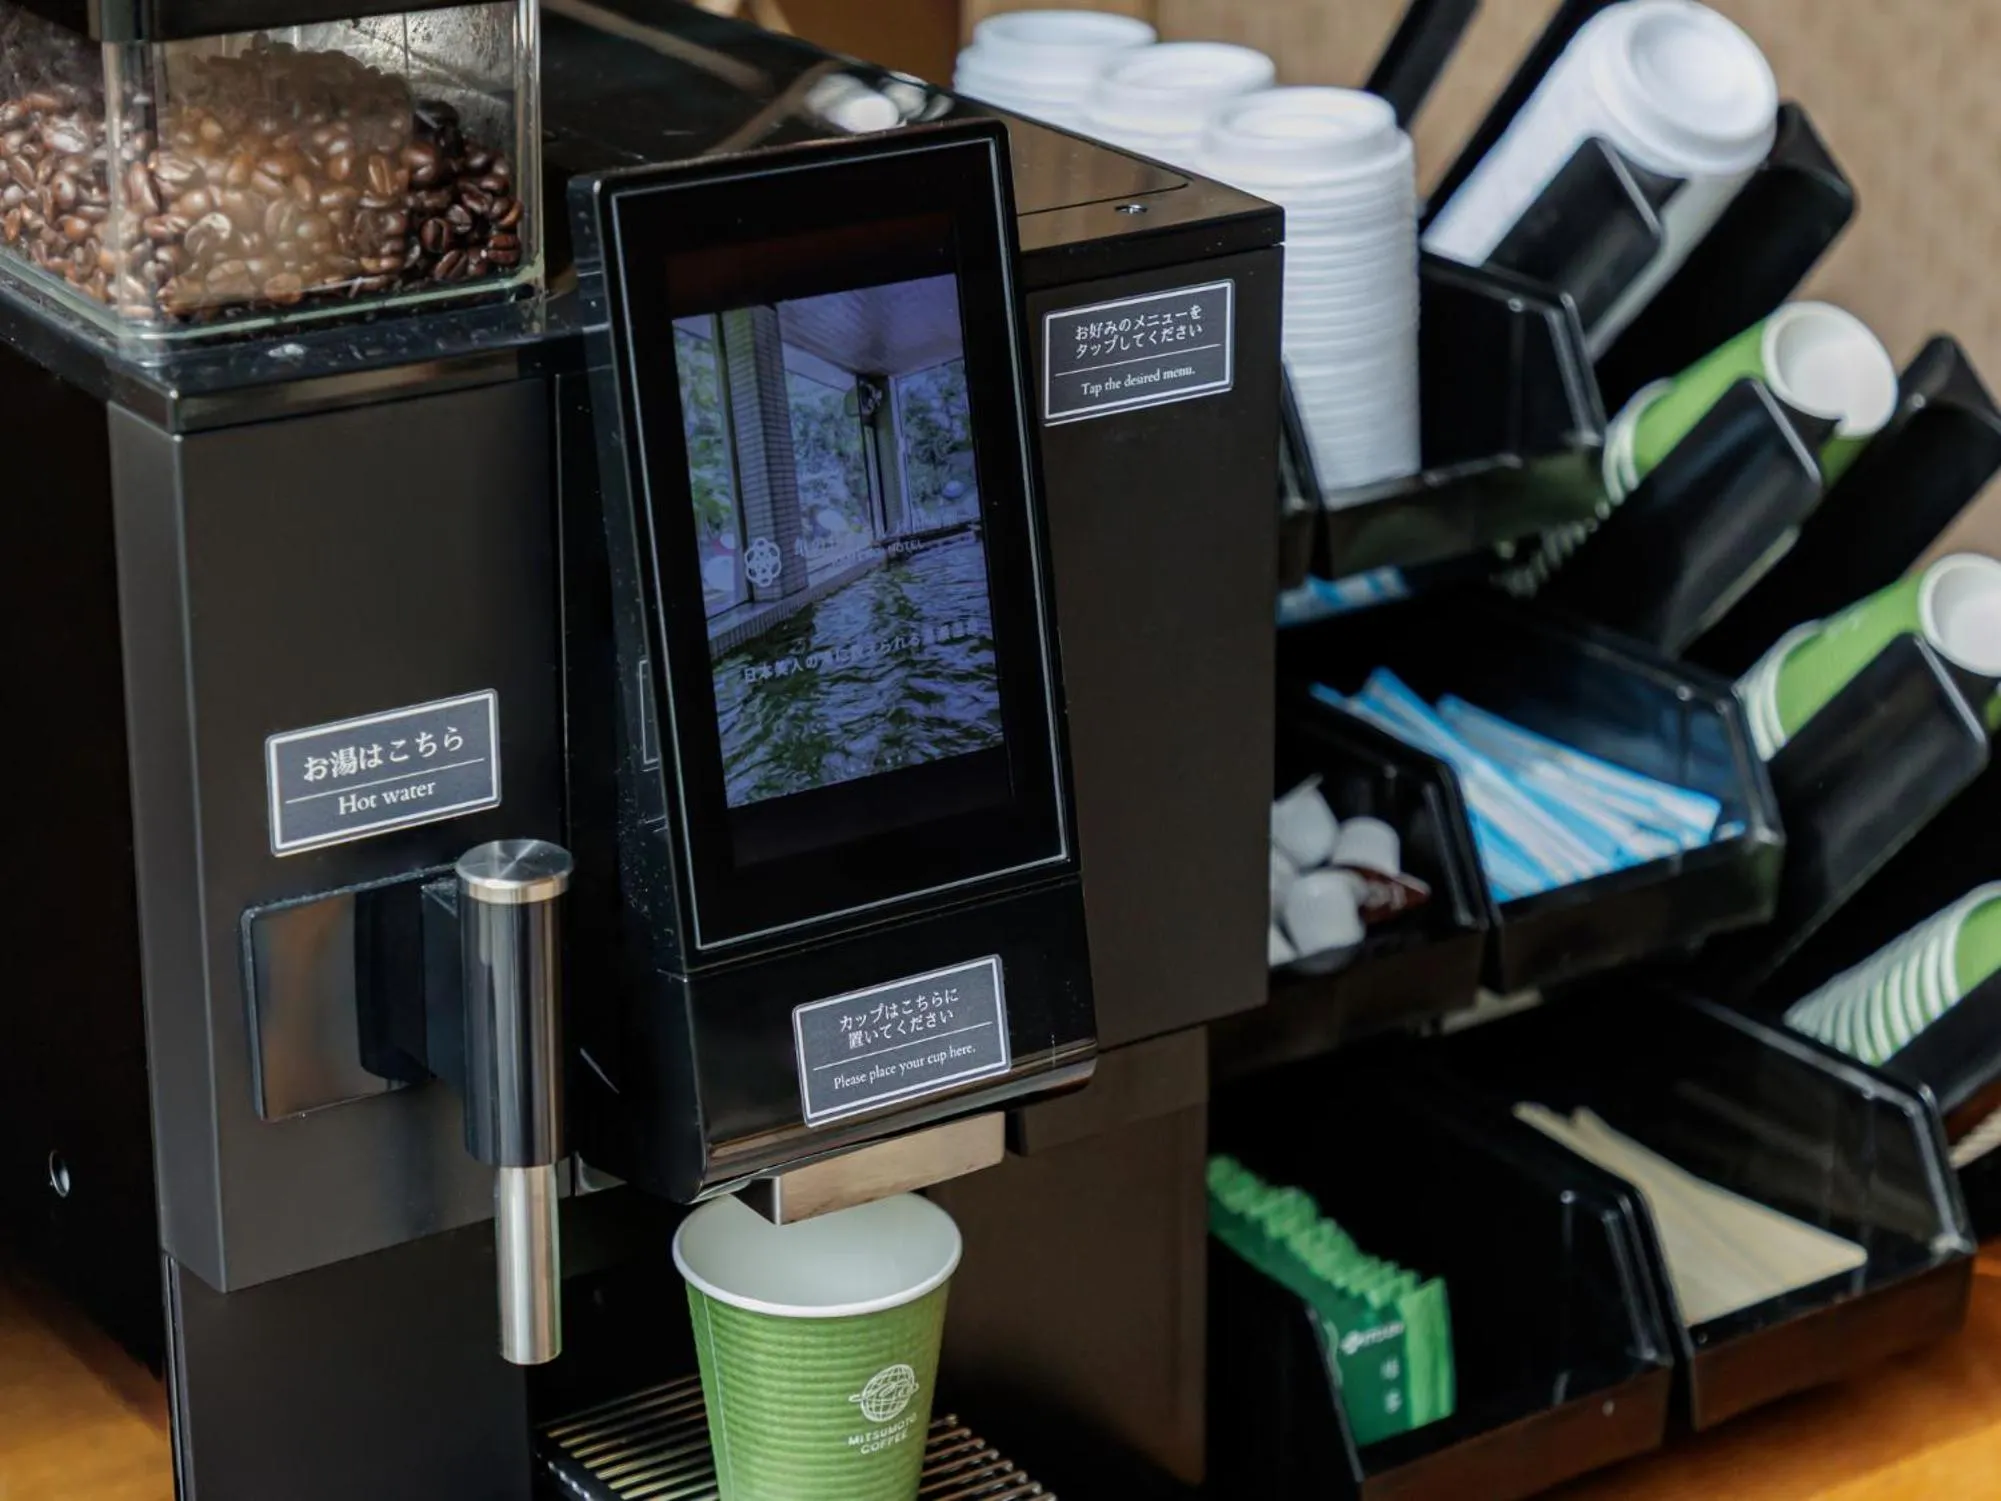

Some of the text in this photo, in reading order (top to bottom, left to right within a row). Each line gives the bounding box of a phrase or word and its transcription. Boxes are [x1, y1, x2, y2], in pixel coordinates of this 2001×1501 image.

[1074, 304, 1203, 341] お好みのメニューを
[1075, 322, 1204, 359] タップしてください
[1081, 365, 1196, 398] Tap the desired menu.
[303, 725, 464, 783] お湯はこちら
[338, 781, 437, 816] Hot water
[839, 987, 960, 1033] カップはこちらに
[848, 1009, 955, 1050] 置いてください
[833, 1043, 976, 1090] Please place your cup here.
[860, 1427, 909, 1455] COFFEE
